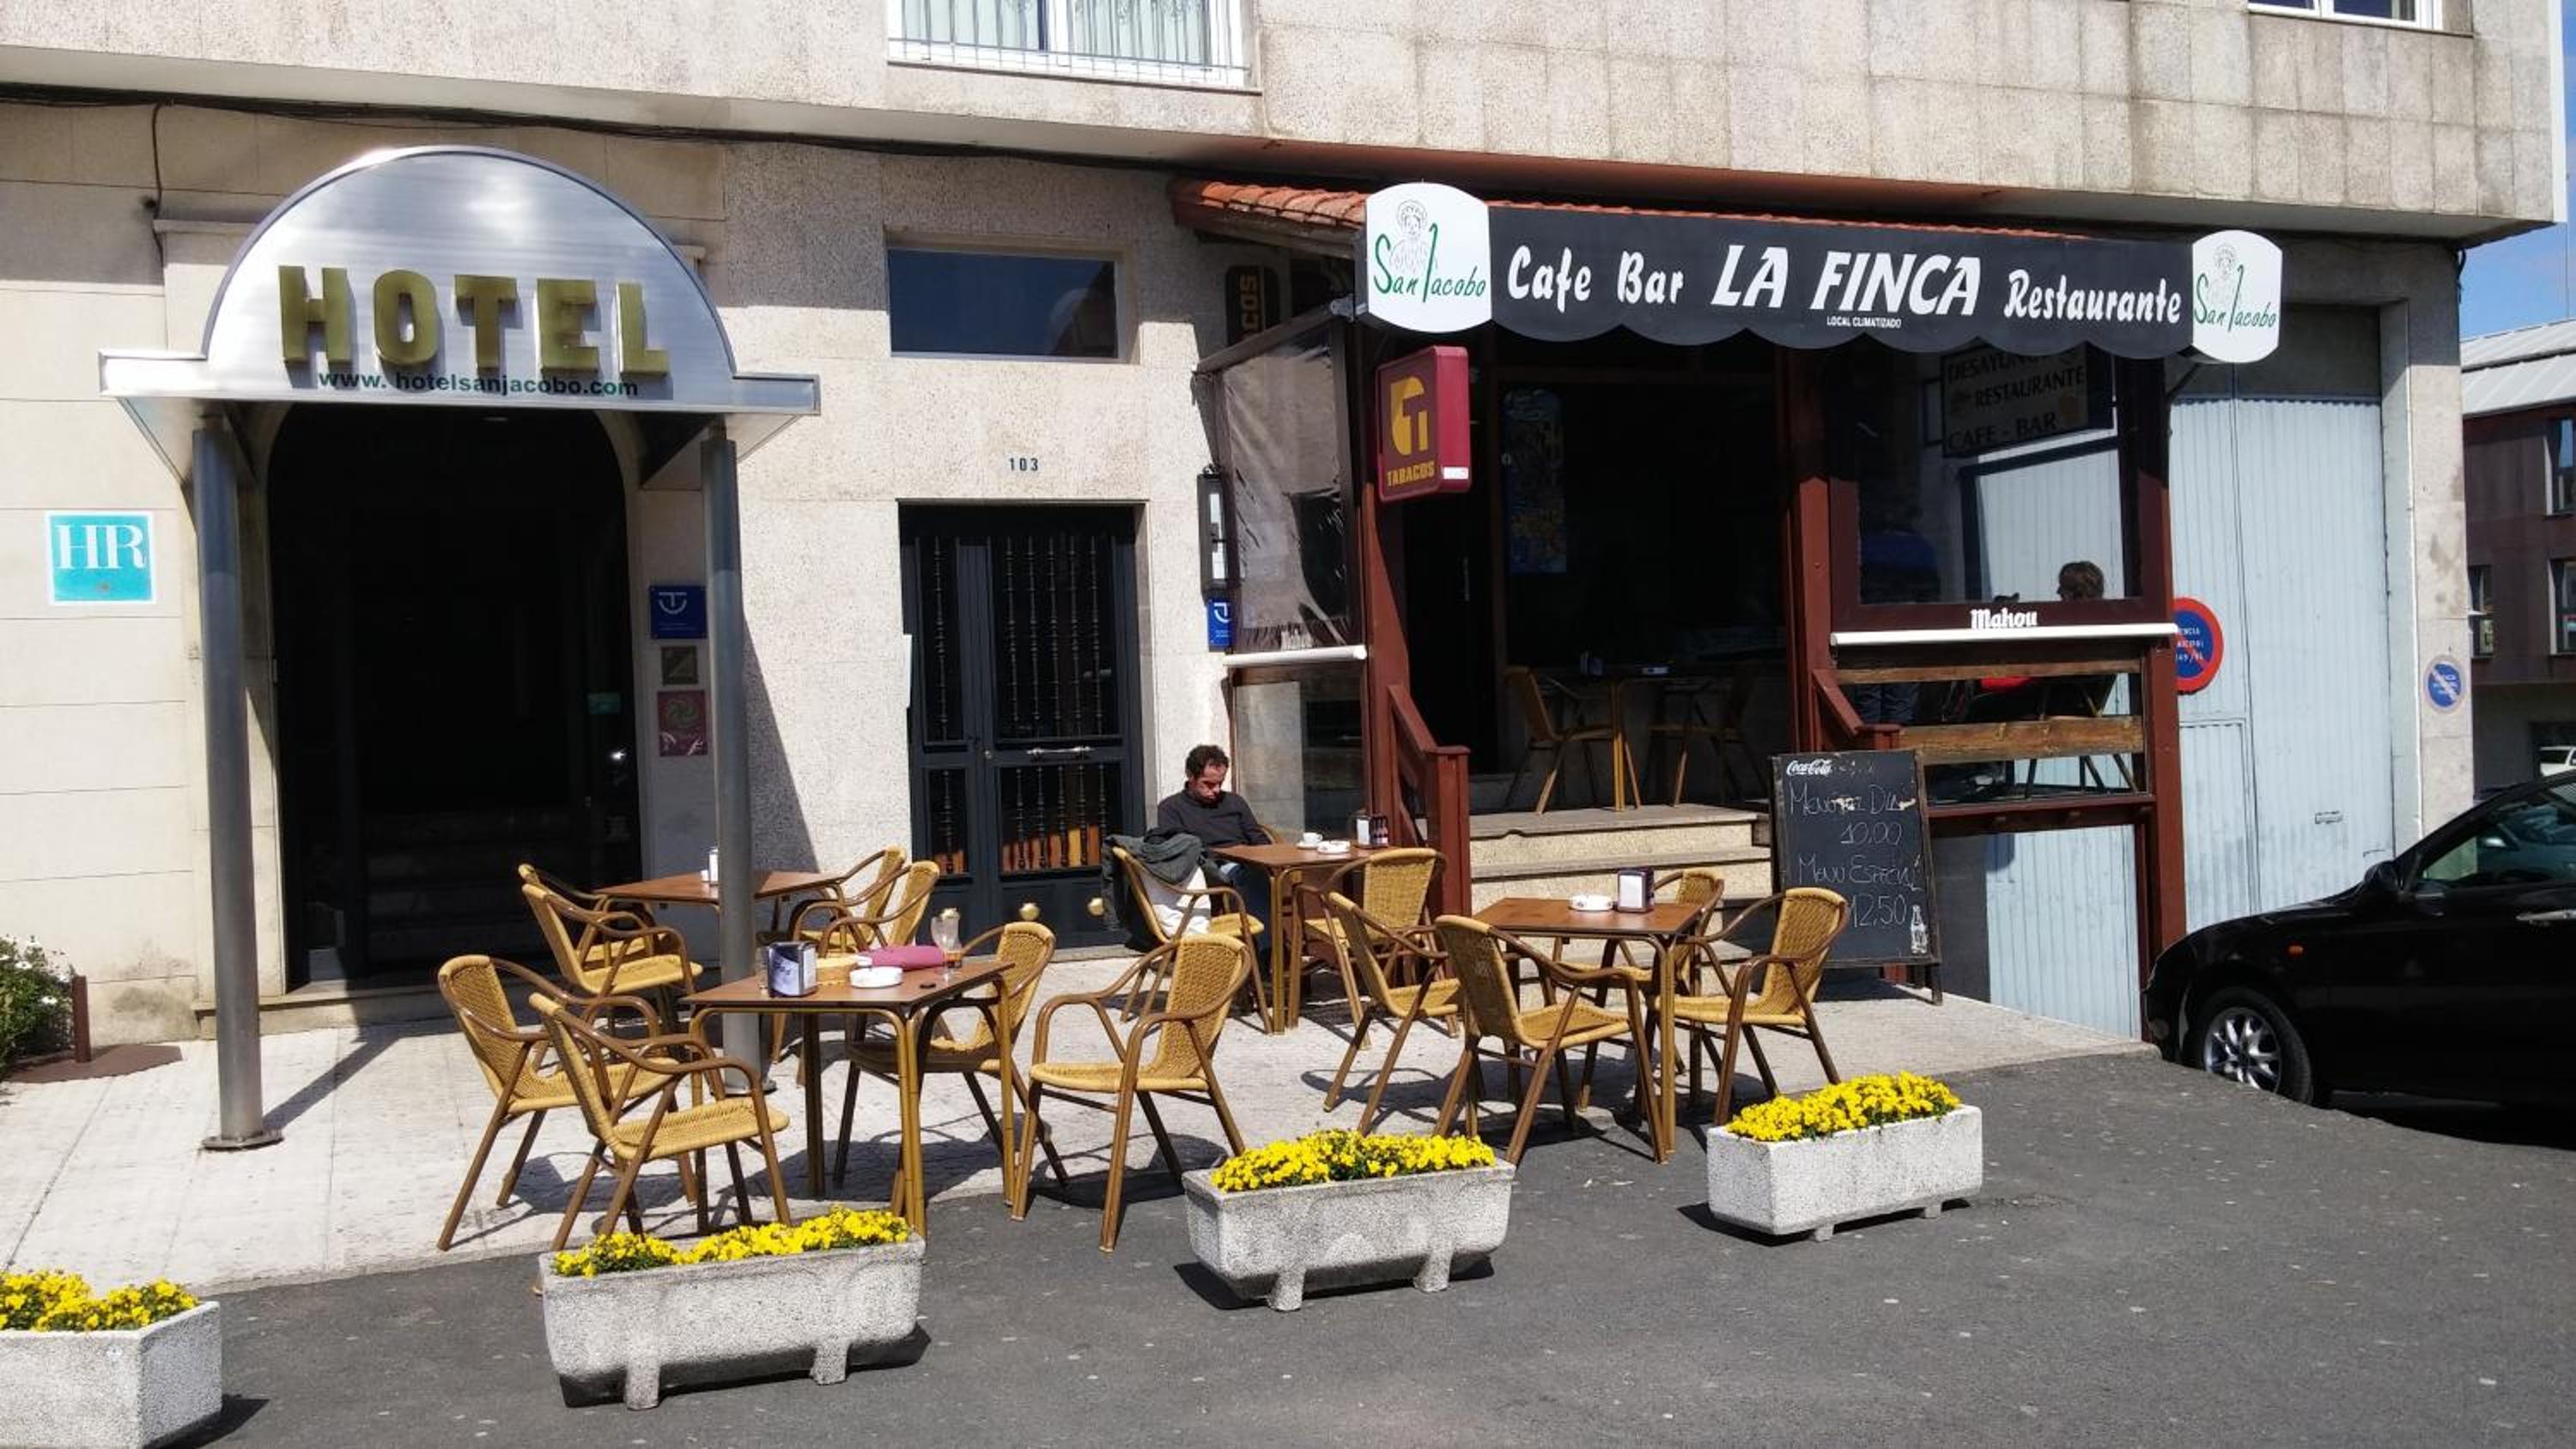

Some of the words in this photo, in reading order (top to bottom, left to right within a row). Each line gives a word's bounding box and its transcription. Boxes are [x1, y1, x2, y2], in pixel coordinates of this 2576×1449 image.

[1373, 233, 1417, 294] San
[1508, 245, 1592, 313] Cafe
[1617, 251, 1684, 304] Bar
[1710, 244, 1789, 308] LA
[1809, 250, 1982, 316] FINCA
[2004, 269, 2182, 324] Restaurante
[2193, 272, 2226, 326] San
[278, 265, 670, 374] HOTEL
[1826, 315, 1850, 326] LOCAL
[1852, 317, 1902, 330] CLIMATIZADO
[1975, 366, 2086, 406] RESTAURANTE
[2014, 411, 2057, 440] BAR
[1008, 457, 1039, 472] 103
[1386, 460, 1436, 487] TABACOS
[53, 524, 147, 569] HR
[1970, 607, 2038, 630] Mahou
